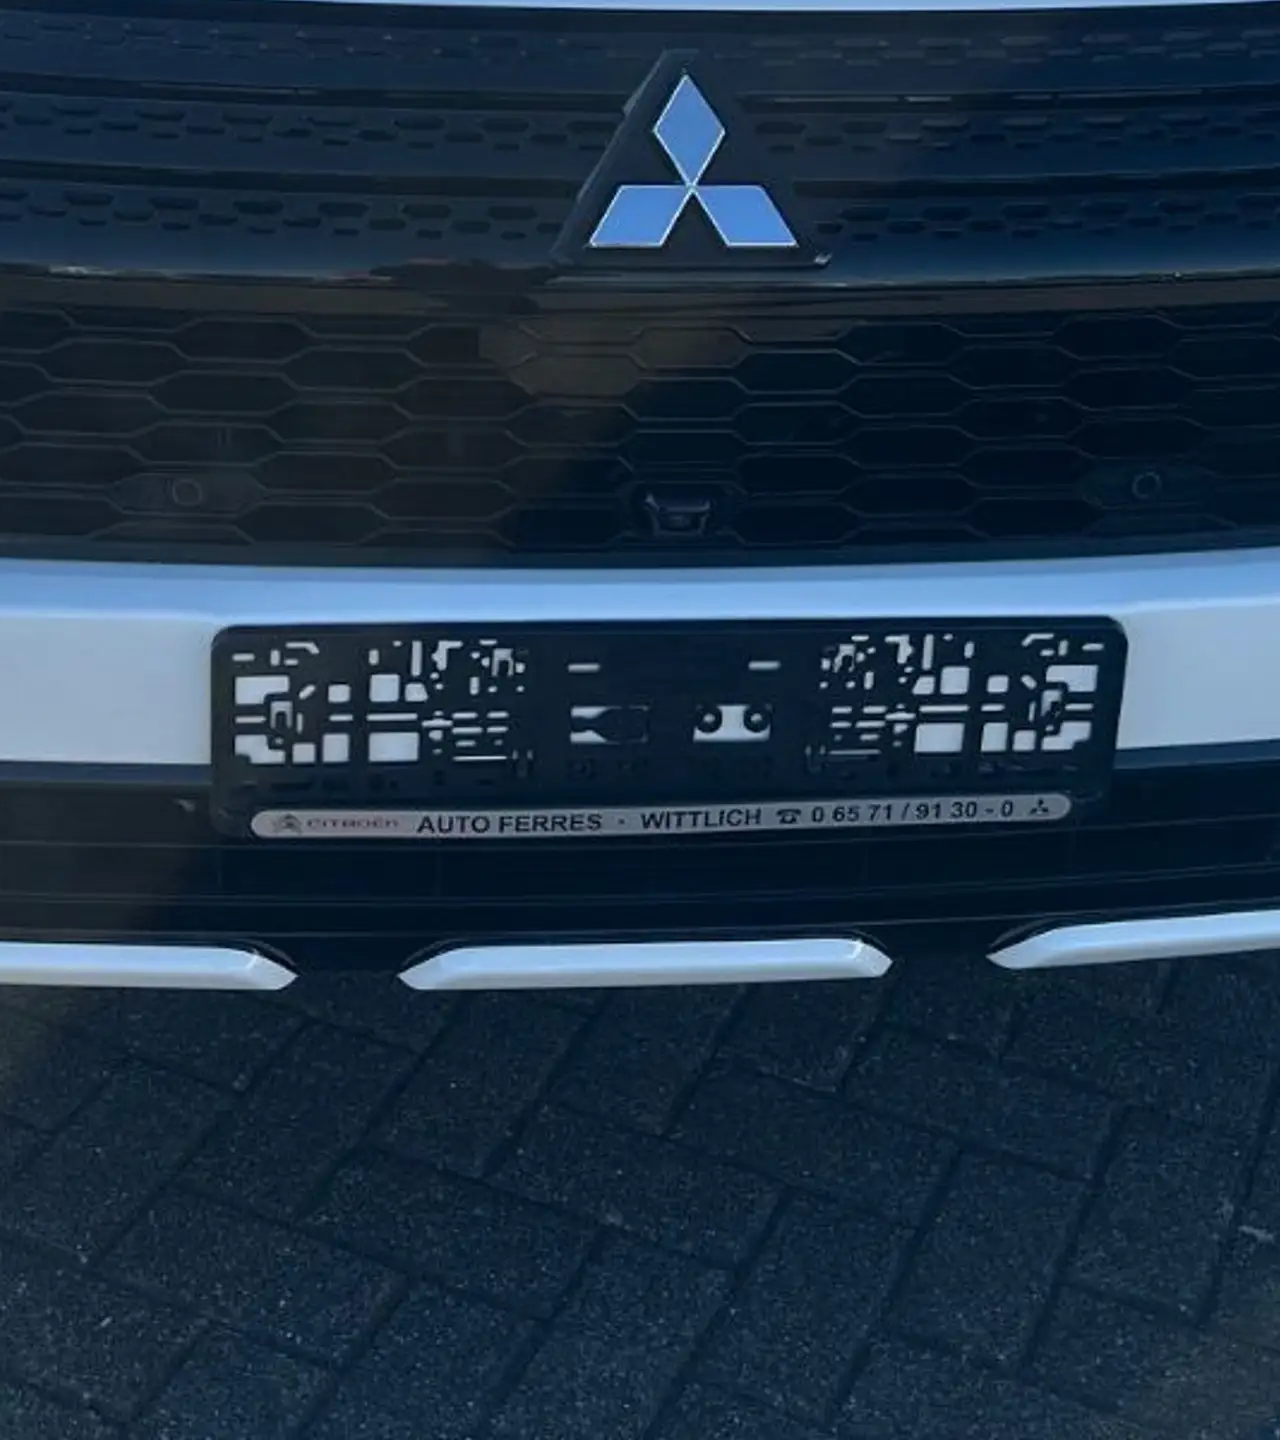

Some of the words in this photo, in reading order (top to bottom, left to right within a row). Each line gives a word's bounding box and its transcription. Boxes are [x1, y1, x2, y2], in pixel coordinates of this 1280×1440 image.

[417, 814, 491, 834] AUTO
[499, 812, 603, 833] FERRES
[640, 807, 762, 831] WITTLICH
[811, 806, 824, 825] 0
[832, 805, 860, 824] 65
[868, 804, 893, 823] 71
[915, 802, 941, 821] 91
[951, 800, 977, 820] 30
[1001, 800, 1014, 818] 0
